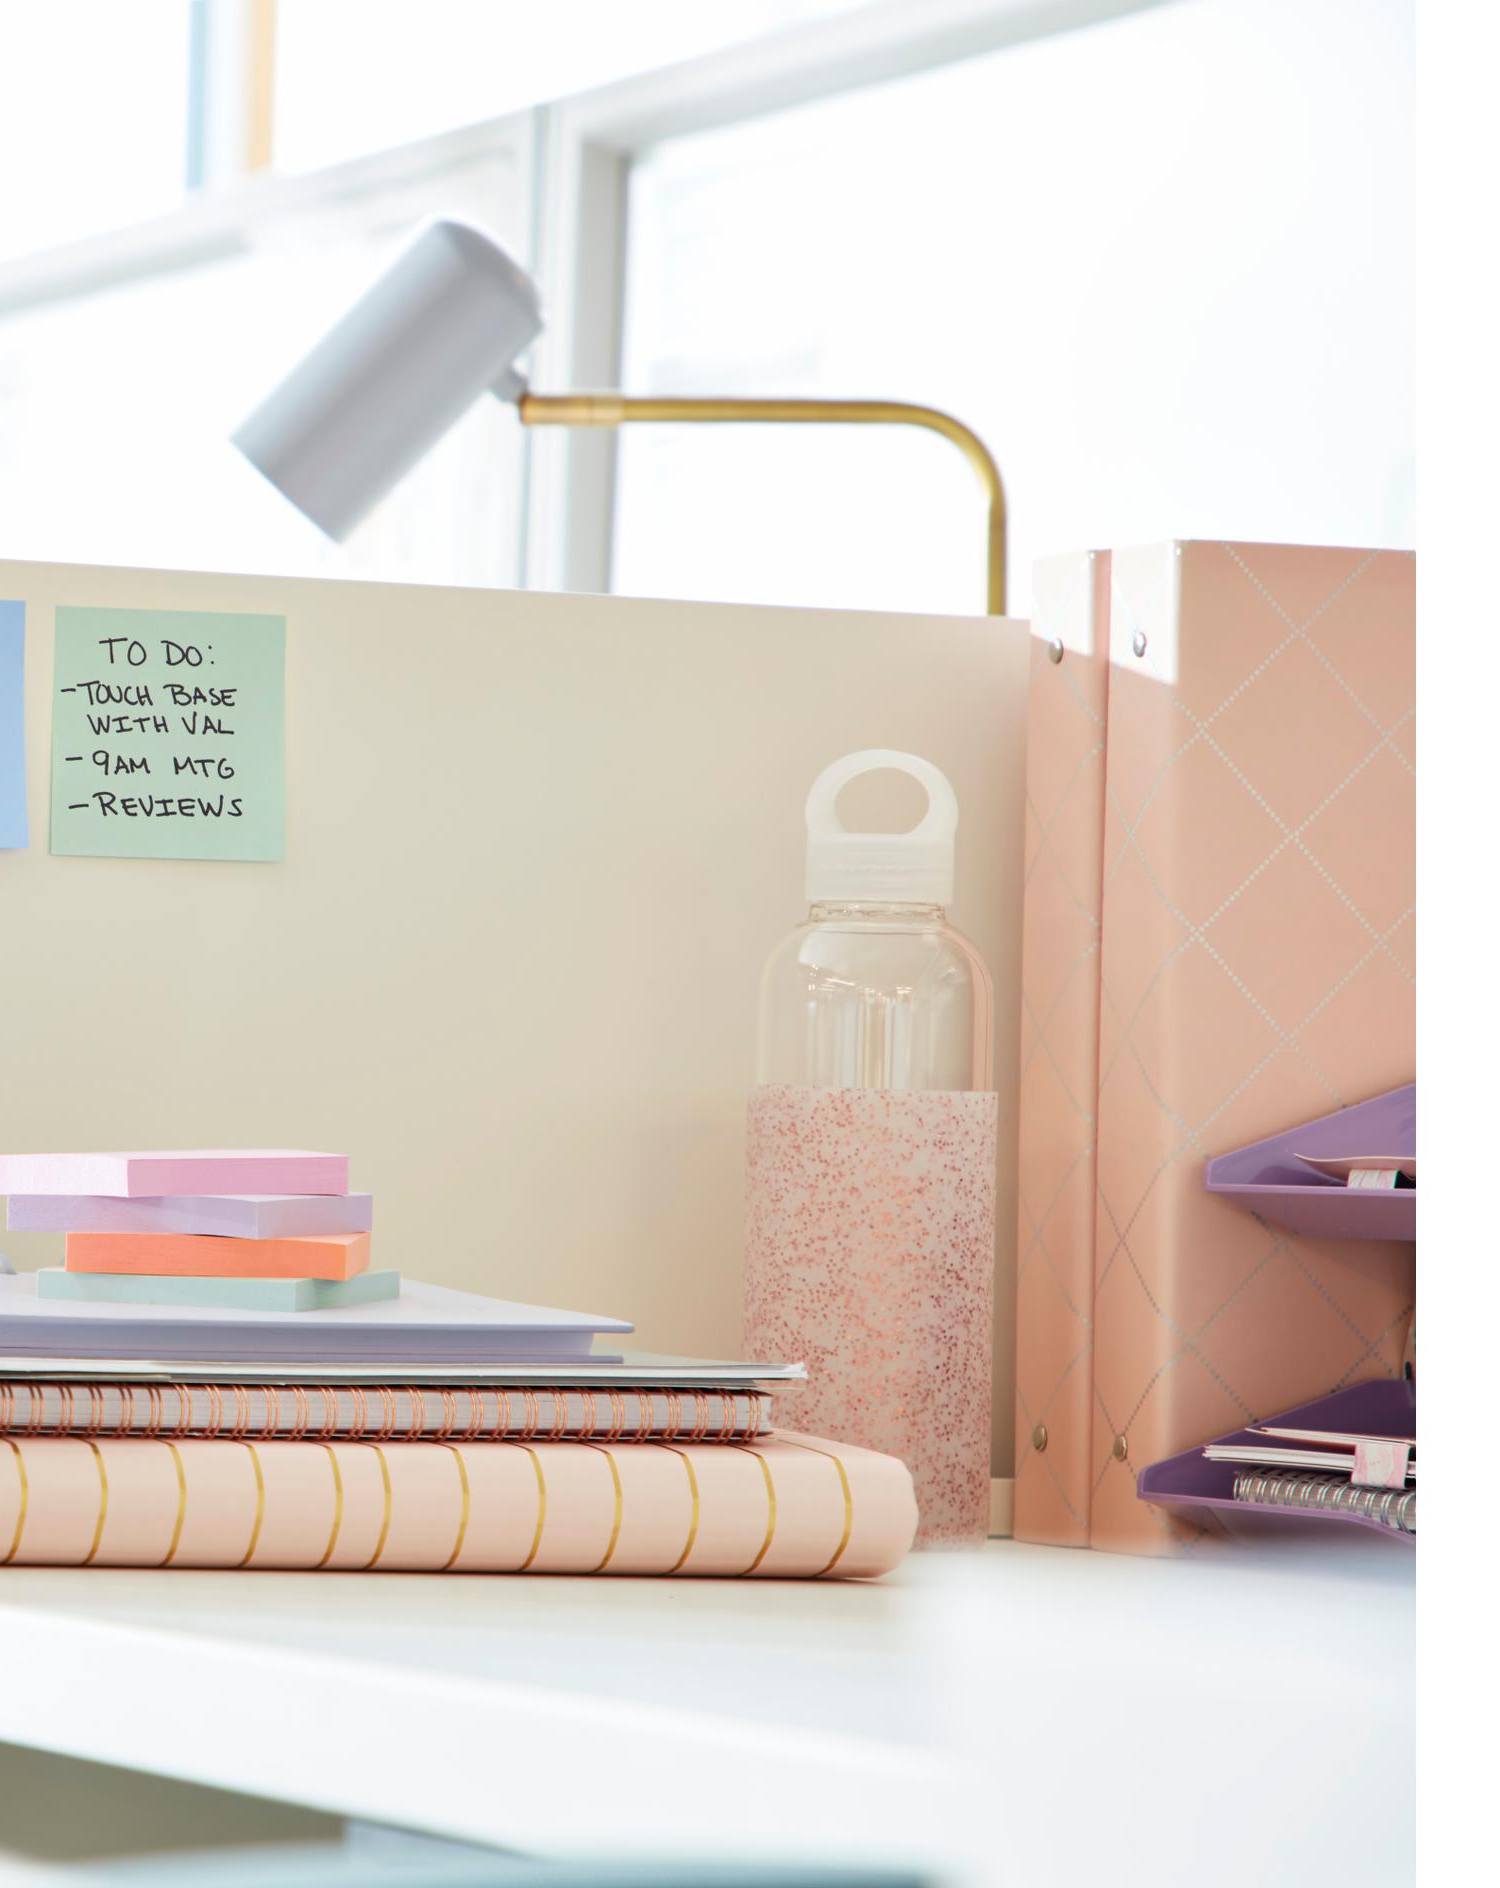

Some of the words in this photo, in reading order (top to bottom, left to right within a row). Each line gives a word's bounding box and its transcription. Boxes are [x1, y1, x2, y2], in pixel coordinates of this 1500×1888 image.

[98, 637, 147, 667] TO
[160, 639, 215, 667] DO:
[162, 683, 238, 707] BASE
[86, 714, 169, 736] WITH
[181, 711, 235, 735] VAL
[173, 756, 235, 780] MTG
